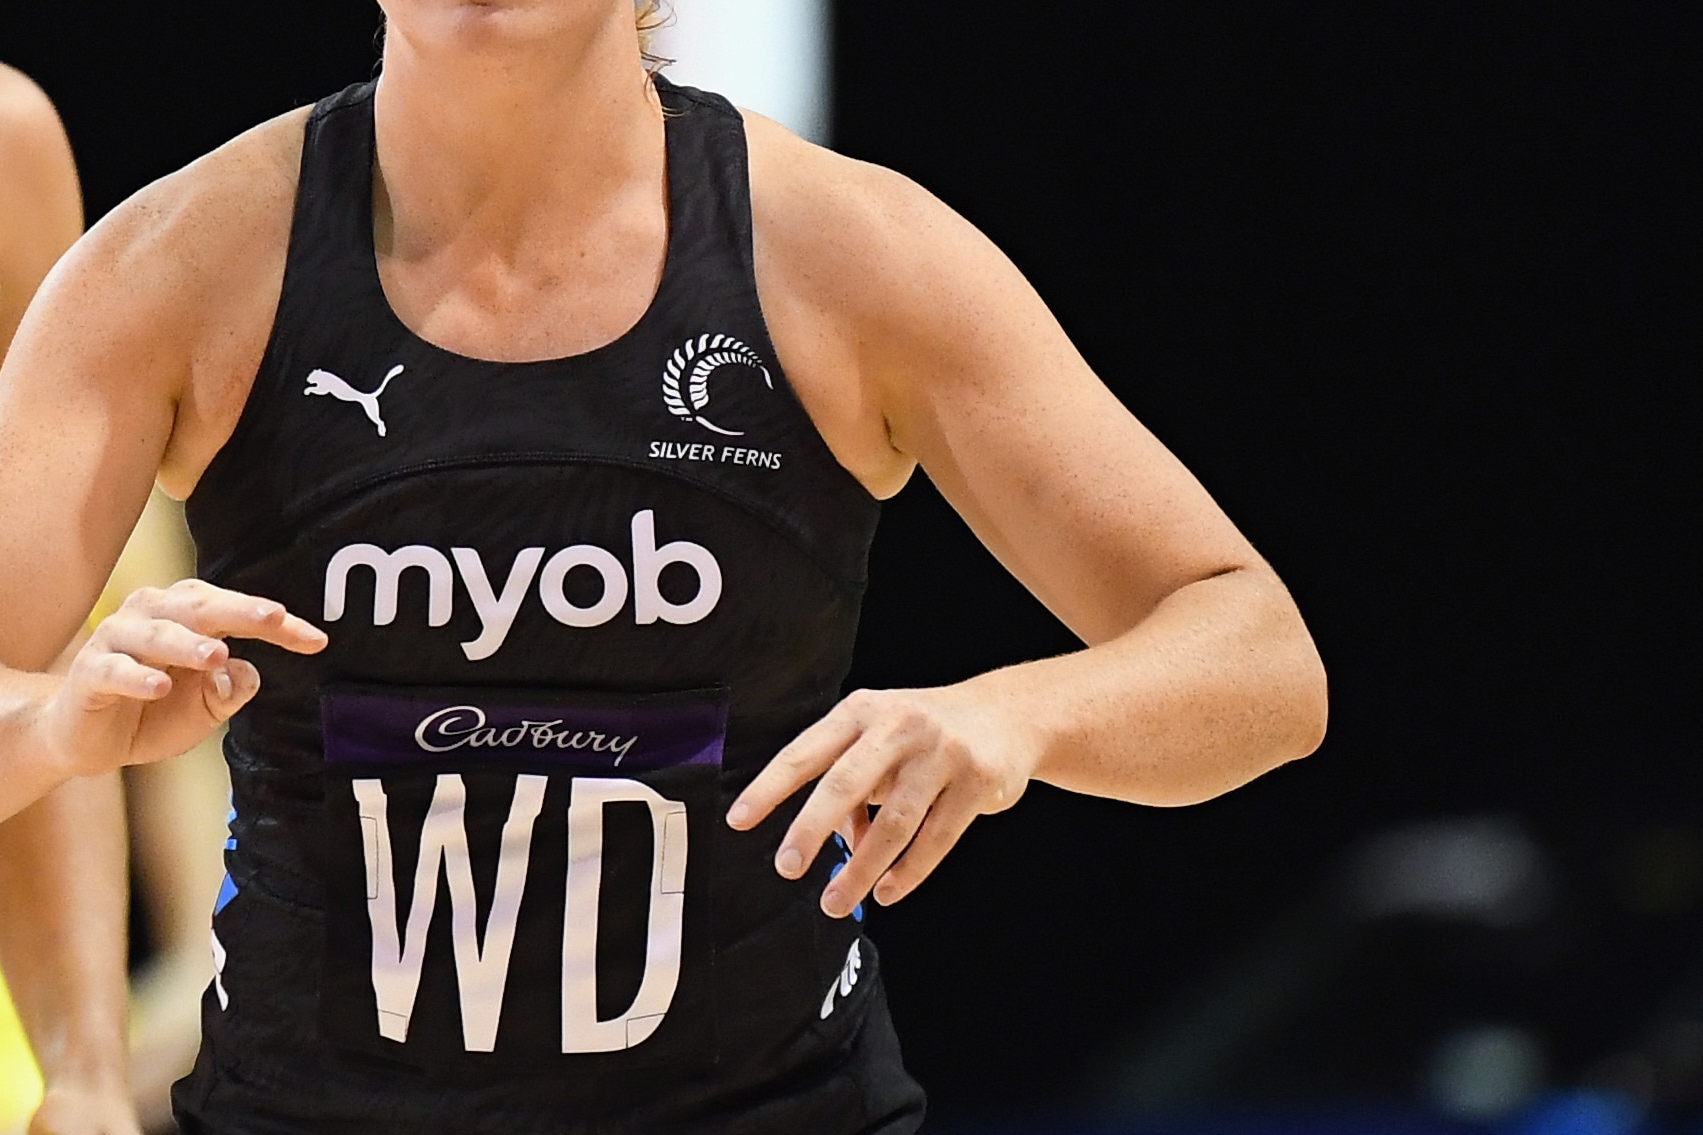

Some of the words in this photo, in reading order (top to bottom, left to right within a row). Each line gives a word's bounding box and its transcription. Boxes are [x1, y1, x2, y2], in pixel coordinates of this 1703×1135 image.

[648, 441, 716, 462] SILVER
[720, 446, 783, 470] FERNS
[323, 509, 723, 661] myob
[414, 705, 638, 767] Cadbury
[352, 773, 688, 1054] WD
